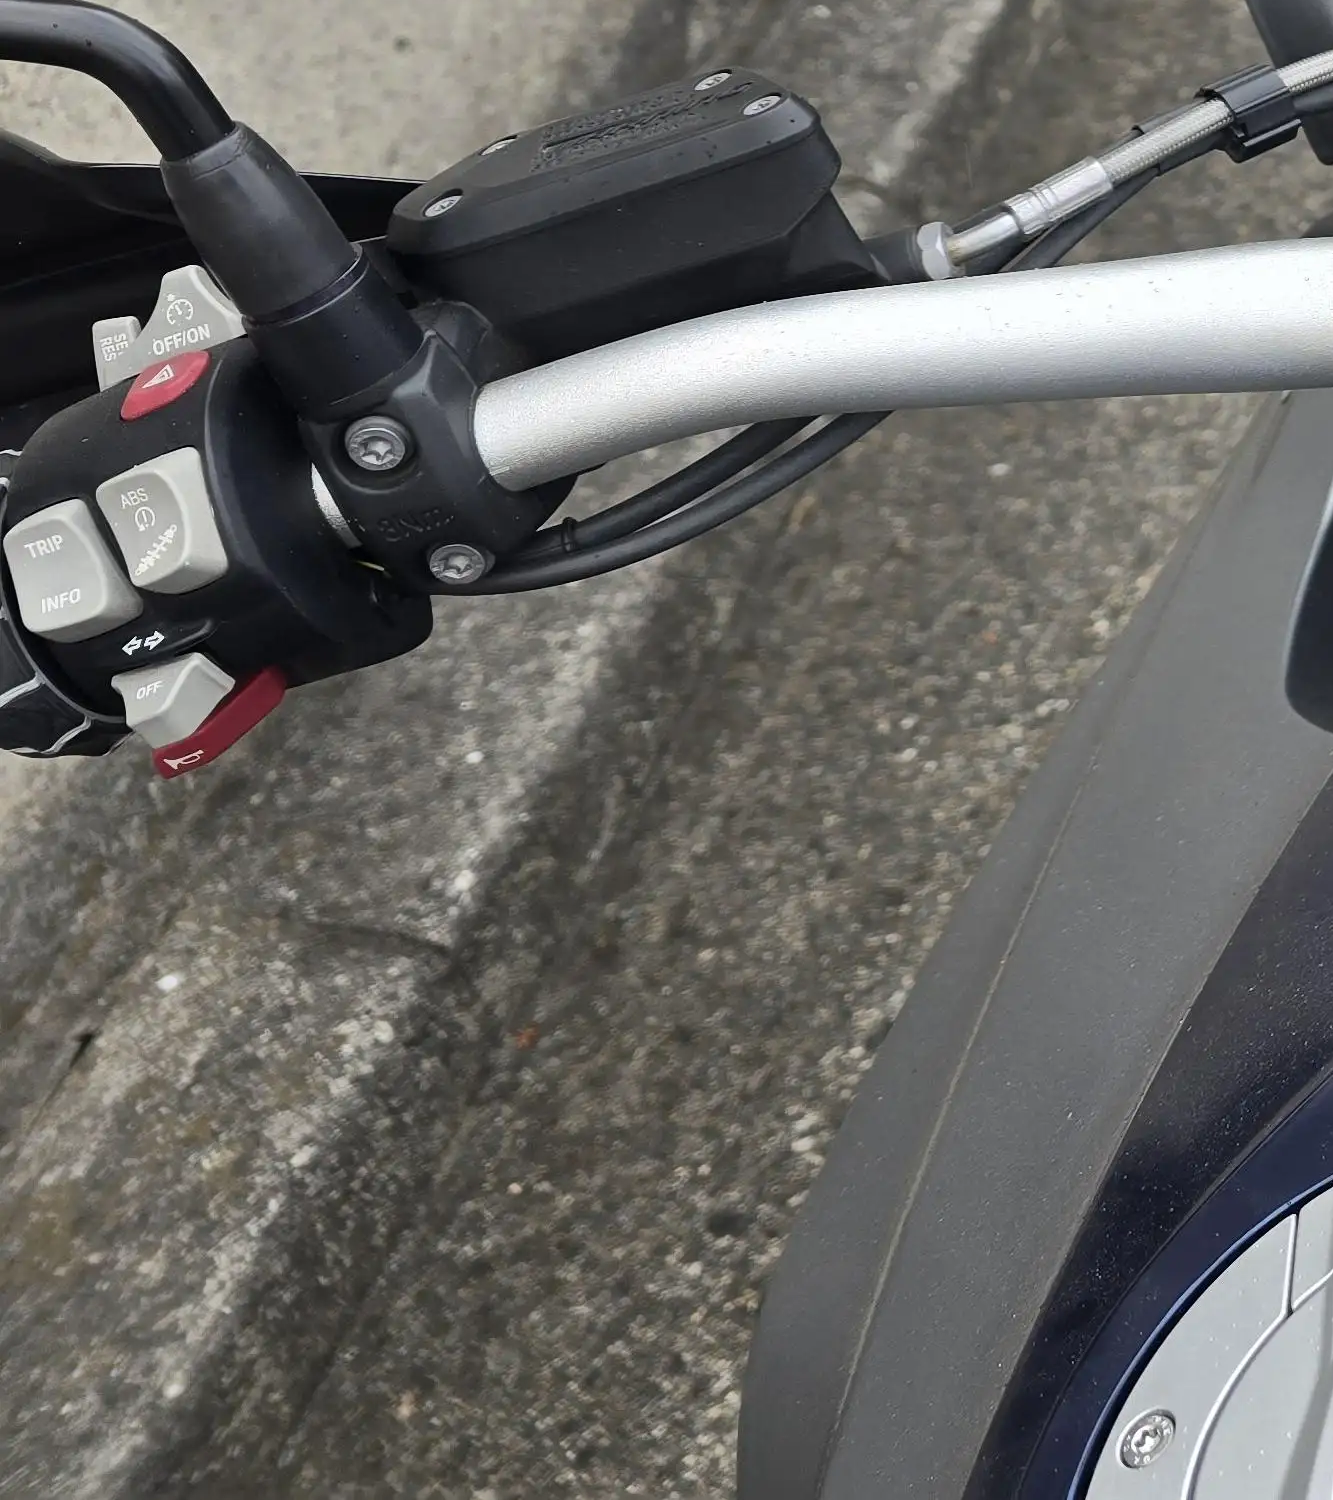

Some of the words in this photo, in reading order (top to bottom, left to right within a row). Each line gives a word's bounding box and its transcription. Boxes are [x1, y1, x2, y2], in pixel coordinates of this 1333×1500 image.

[100, 337, 117, 362] RES
[114, 333, 129, 356] SE
[152, 323, 211, 356] OFF/ON
[120, 488, 148, 509] ABS
[24, 534, 64, 559] TRIP
[41, 588, 81, 614] INFO
[136, 680, 164, 700] OFF
